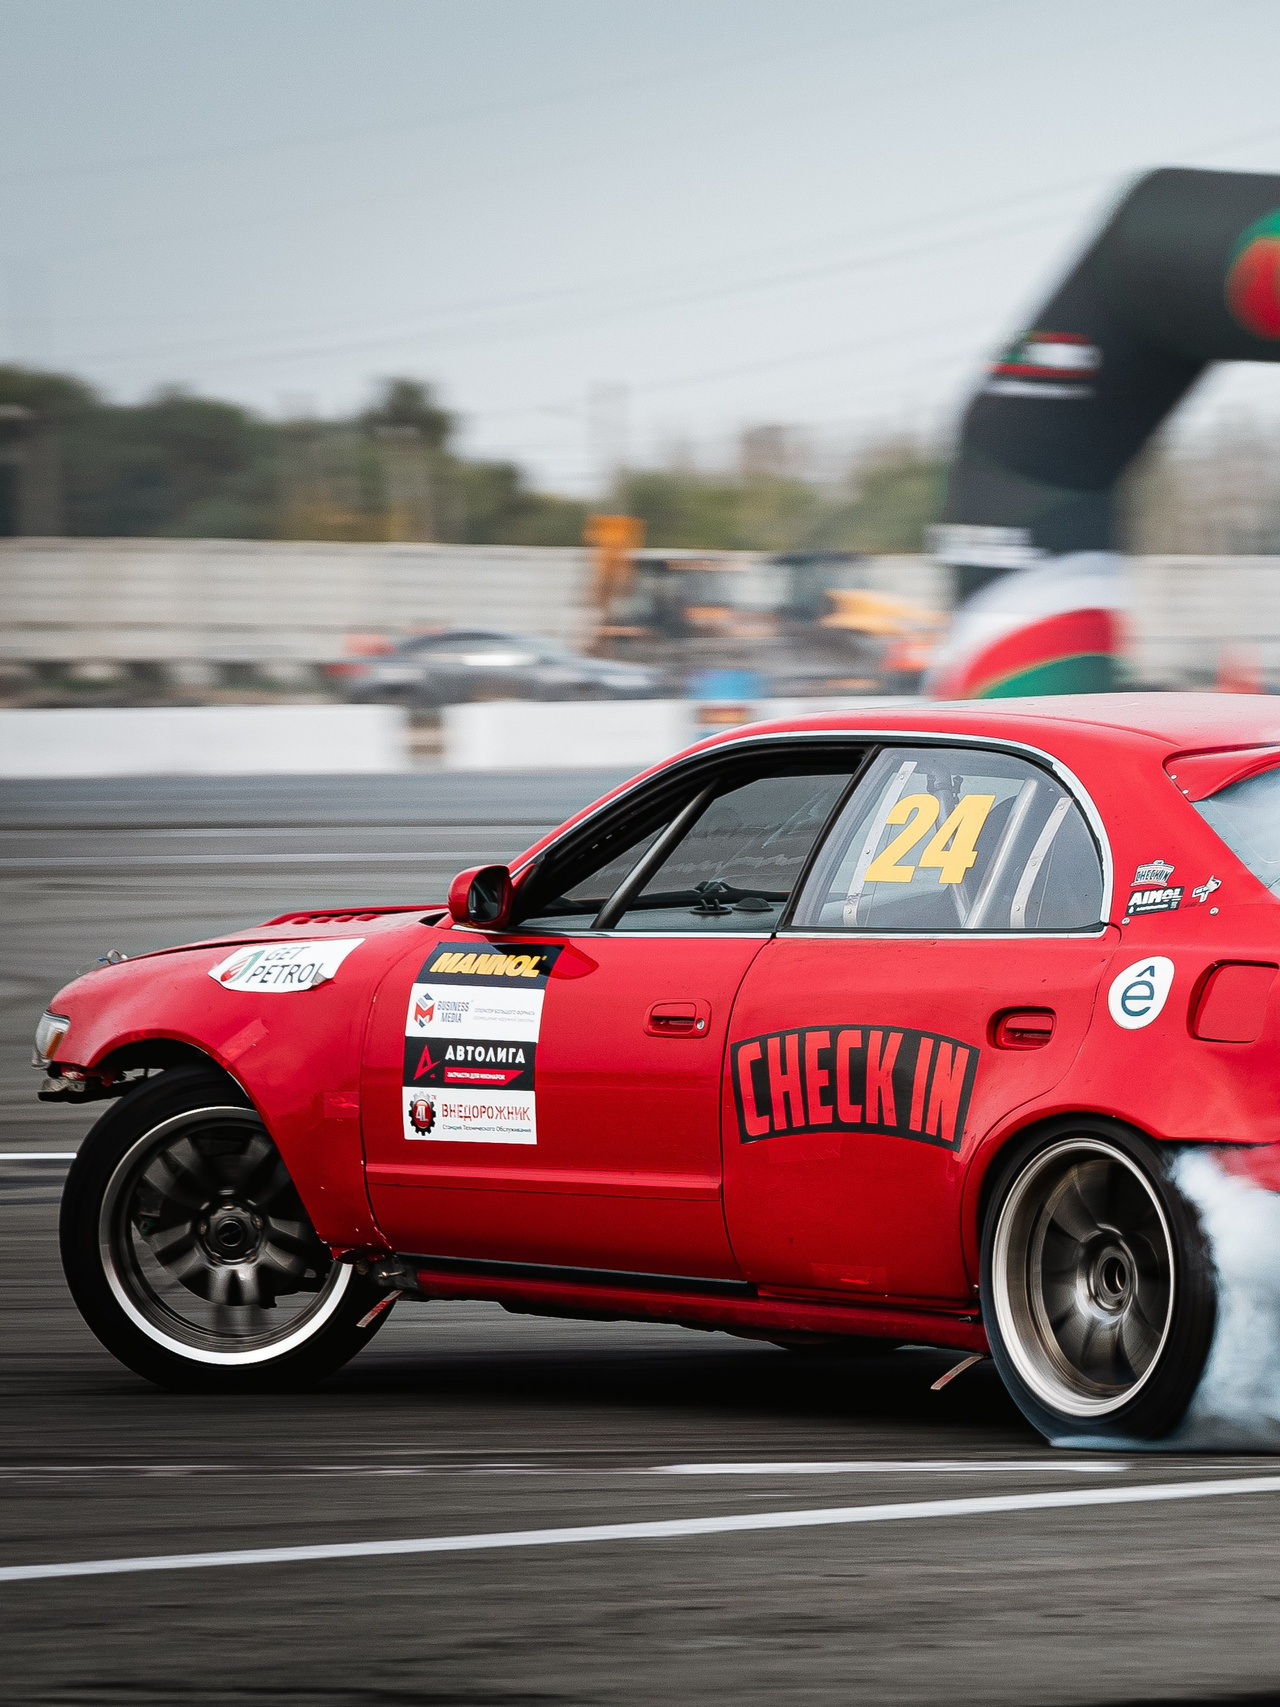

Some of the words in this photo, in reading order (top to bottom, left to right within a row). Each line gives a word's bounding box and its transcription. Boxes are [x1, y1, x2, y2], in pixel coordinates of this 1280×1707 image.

[864, 793, 996, 884] 24
[265, 946, 311, 961] GET
[429, 952, 541, 978] MANNOL
[437, 1000, 469, 1012] BUSINESS
[441, 1012, 462, 1023] MEDIA
[444, 1045, 526, 1064] АВТОЛИГА
[737, 1029, 904, 1137] CHECK
[908, 1036, 970, 1142] IN
[441, 1103, 531, 1122] ВНЕДОРОЖНИК
